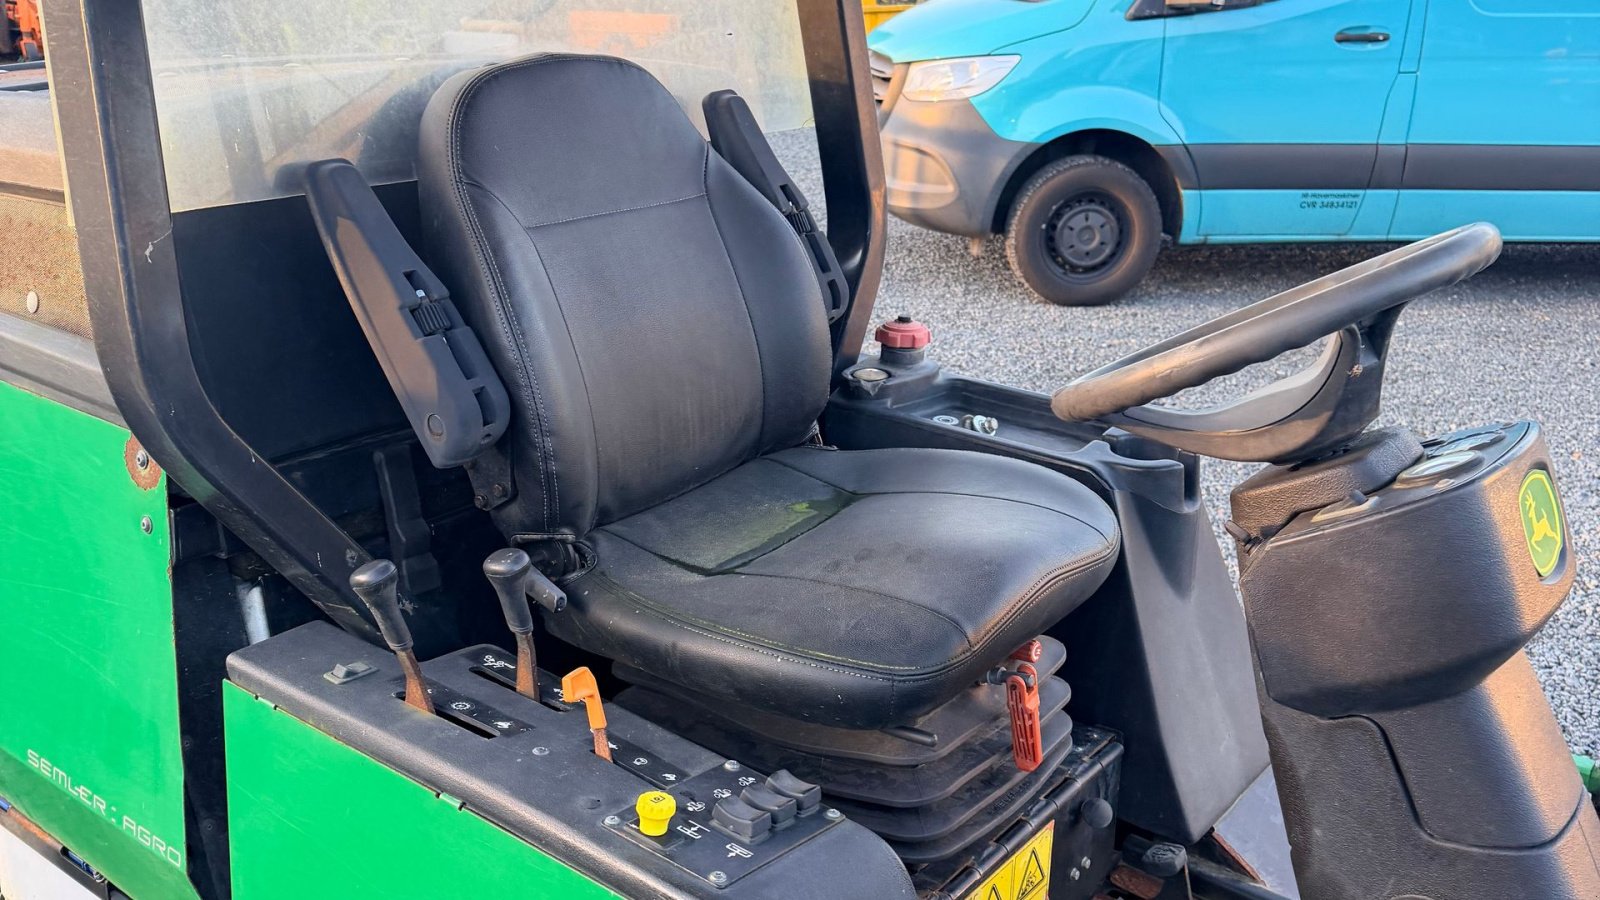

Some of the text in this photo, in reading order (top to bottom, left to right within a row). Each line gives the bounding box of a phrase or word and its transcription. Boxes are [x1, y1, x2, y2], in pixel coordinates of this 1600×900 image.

[1300, 201, 1317, 209] CVR
[27, 749, 106, 816] SEMLER
[122, 815, 182, 868] AGRO
